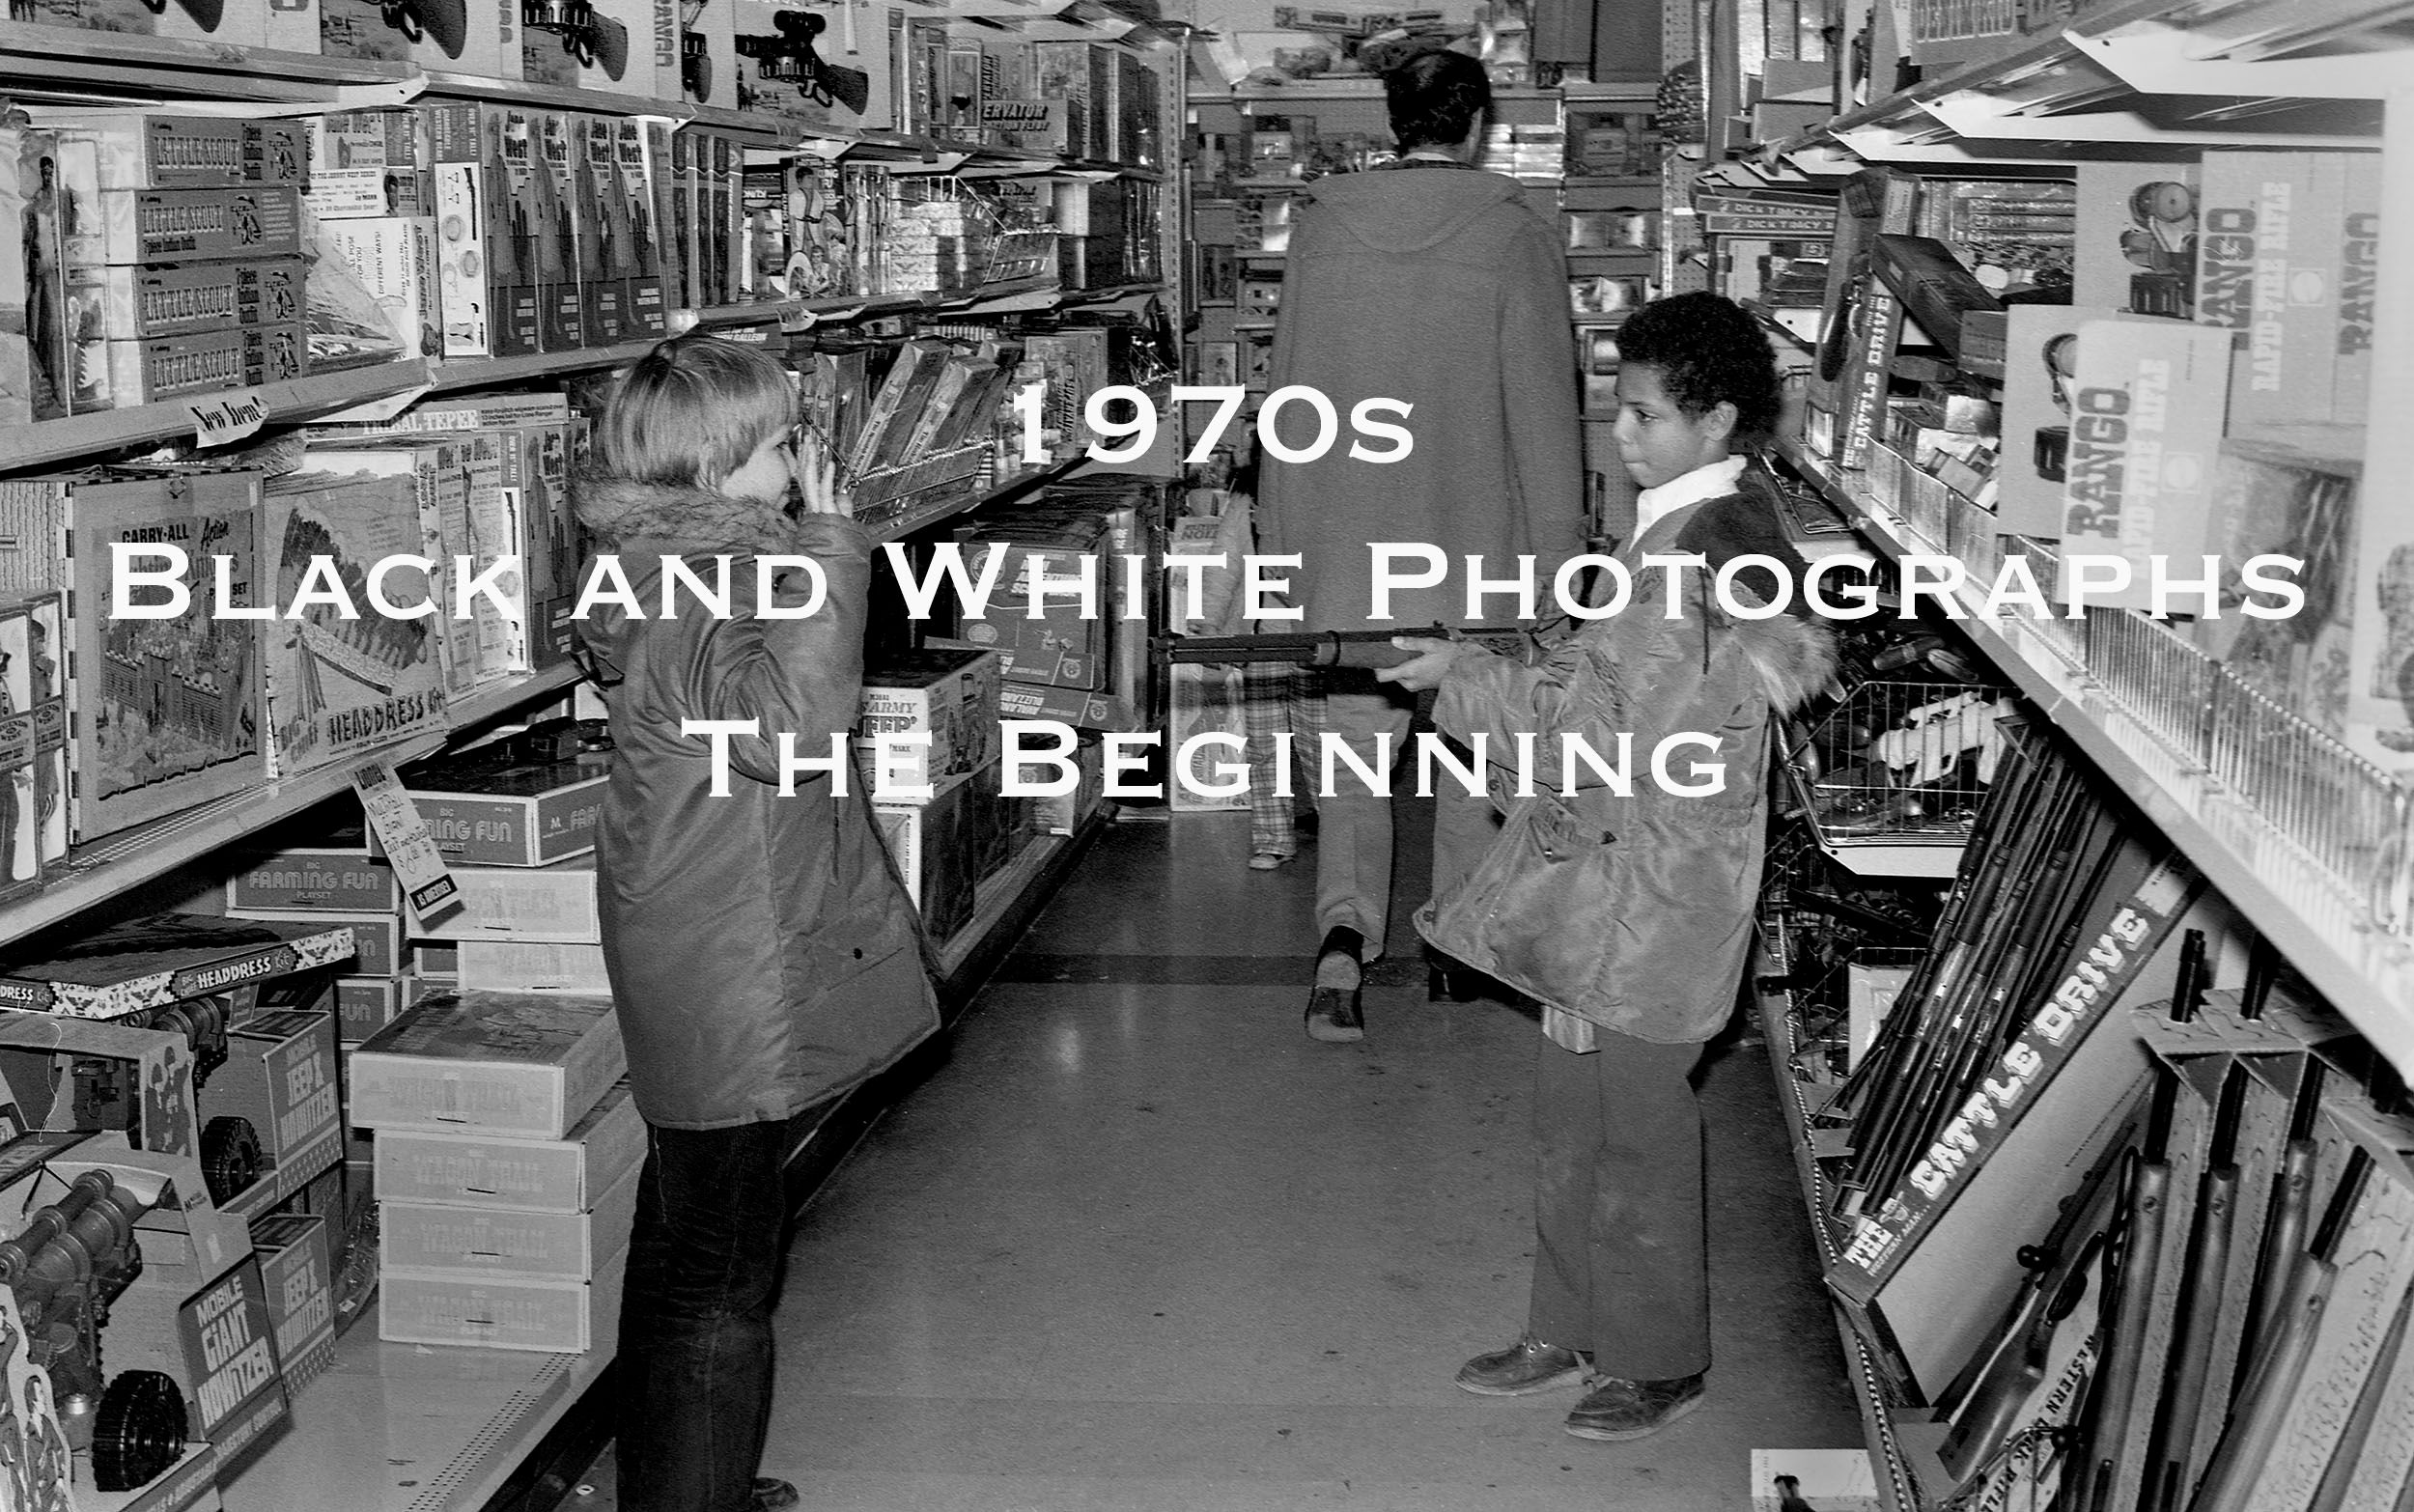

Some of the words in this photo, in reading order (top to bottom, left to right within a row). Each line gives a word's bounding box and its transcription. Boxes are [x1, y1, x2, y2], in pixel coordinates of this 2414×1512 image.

[154, 136, 204, 170] LITTLE
[204, 137, 239, 170] SCOUT
[143, 206, 189, 237] LITTLE
[190, 204, 223, 232] SCOUT
[1746, 219, 1777, 229] DICK
[2260, 182, 2291, 252] RIFLE
[2200, 206, 2257, 351] ANGO
[2338, 211, 2380, 356] RANGO
[145, 289, 195, 325] LITTLE
[195, 284, 233, 320] SCOUT
[2251, 258, 2288, 393] RAPID-FIRE
[1867, 296, 1892, 366] DRIVE
[153, 352, 204, 390] LITTLE
[203, 348, 239, 383] SCOUT
[2137, 358, 2171, 433] RIFLE
[424, 408, 479, 432] TEPEE
[2065, 386, 2131, 540] RANGO
[232, 582, 247, 596] SET
[327, 689, 426, 747] HEADDRESS
[870, 703, 917, 715] ARMY
[435, 842, 466, 854] LAYSET
[475, 820, 513, 844] FUN
[248, 871, 338, 890] FARMING
[342, 871, 379, 891] FUN
[296, 891, 332, 900] PLAYSET
[197, 957, 274, 991] HEADDRESS
[1909, 1040, 2044, 1201] CATTLE
[2032, 907, 2153, 1048] DRIVE
[1844, 1219, 1895, 1271] THE
[196, 1275, 245, 1329] MOBILE
[197, 1336, 276, 1430] HOWITZER
[2044, 1334, 2095, 1415] WESTERN
